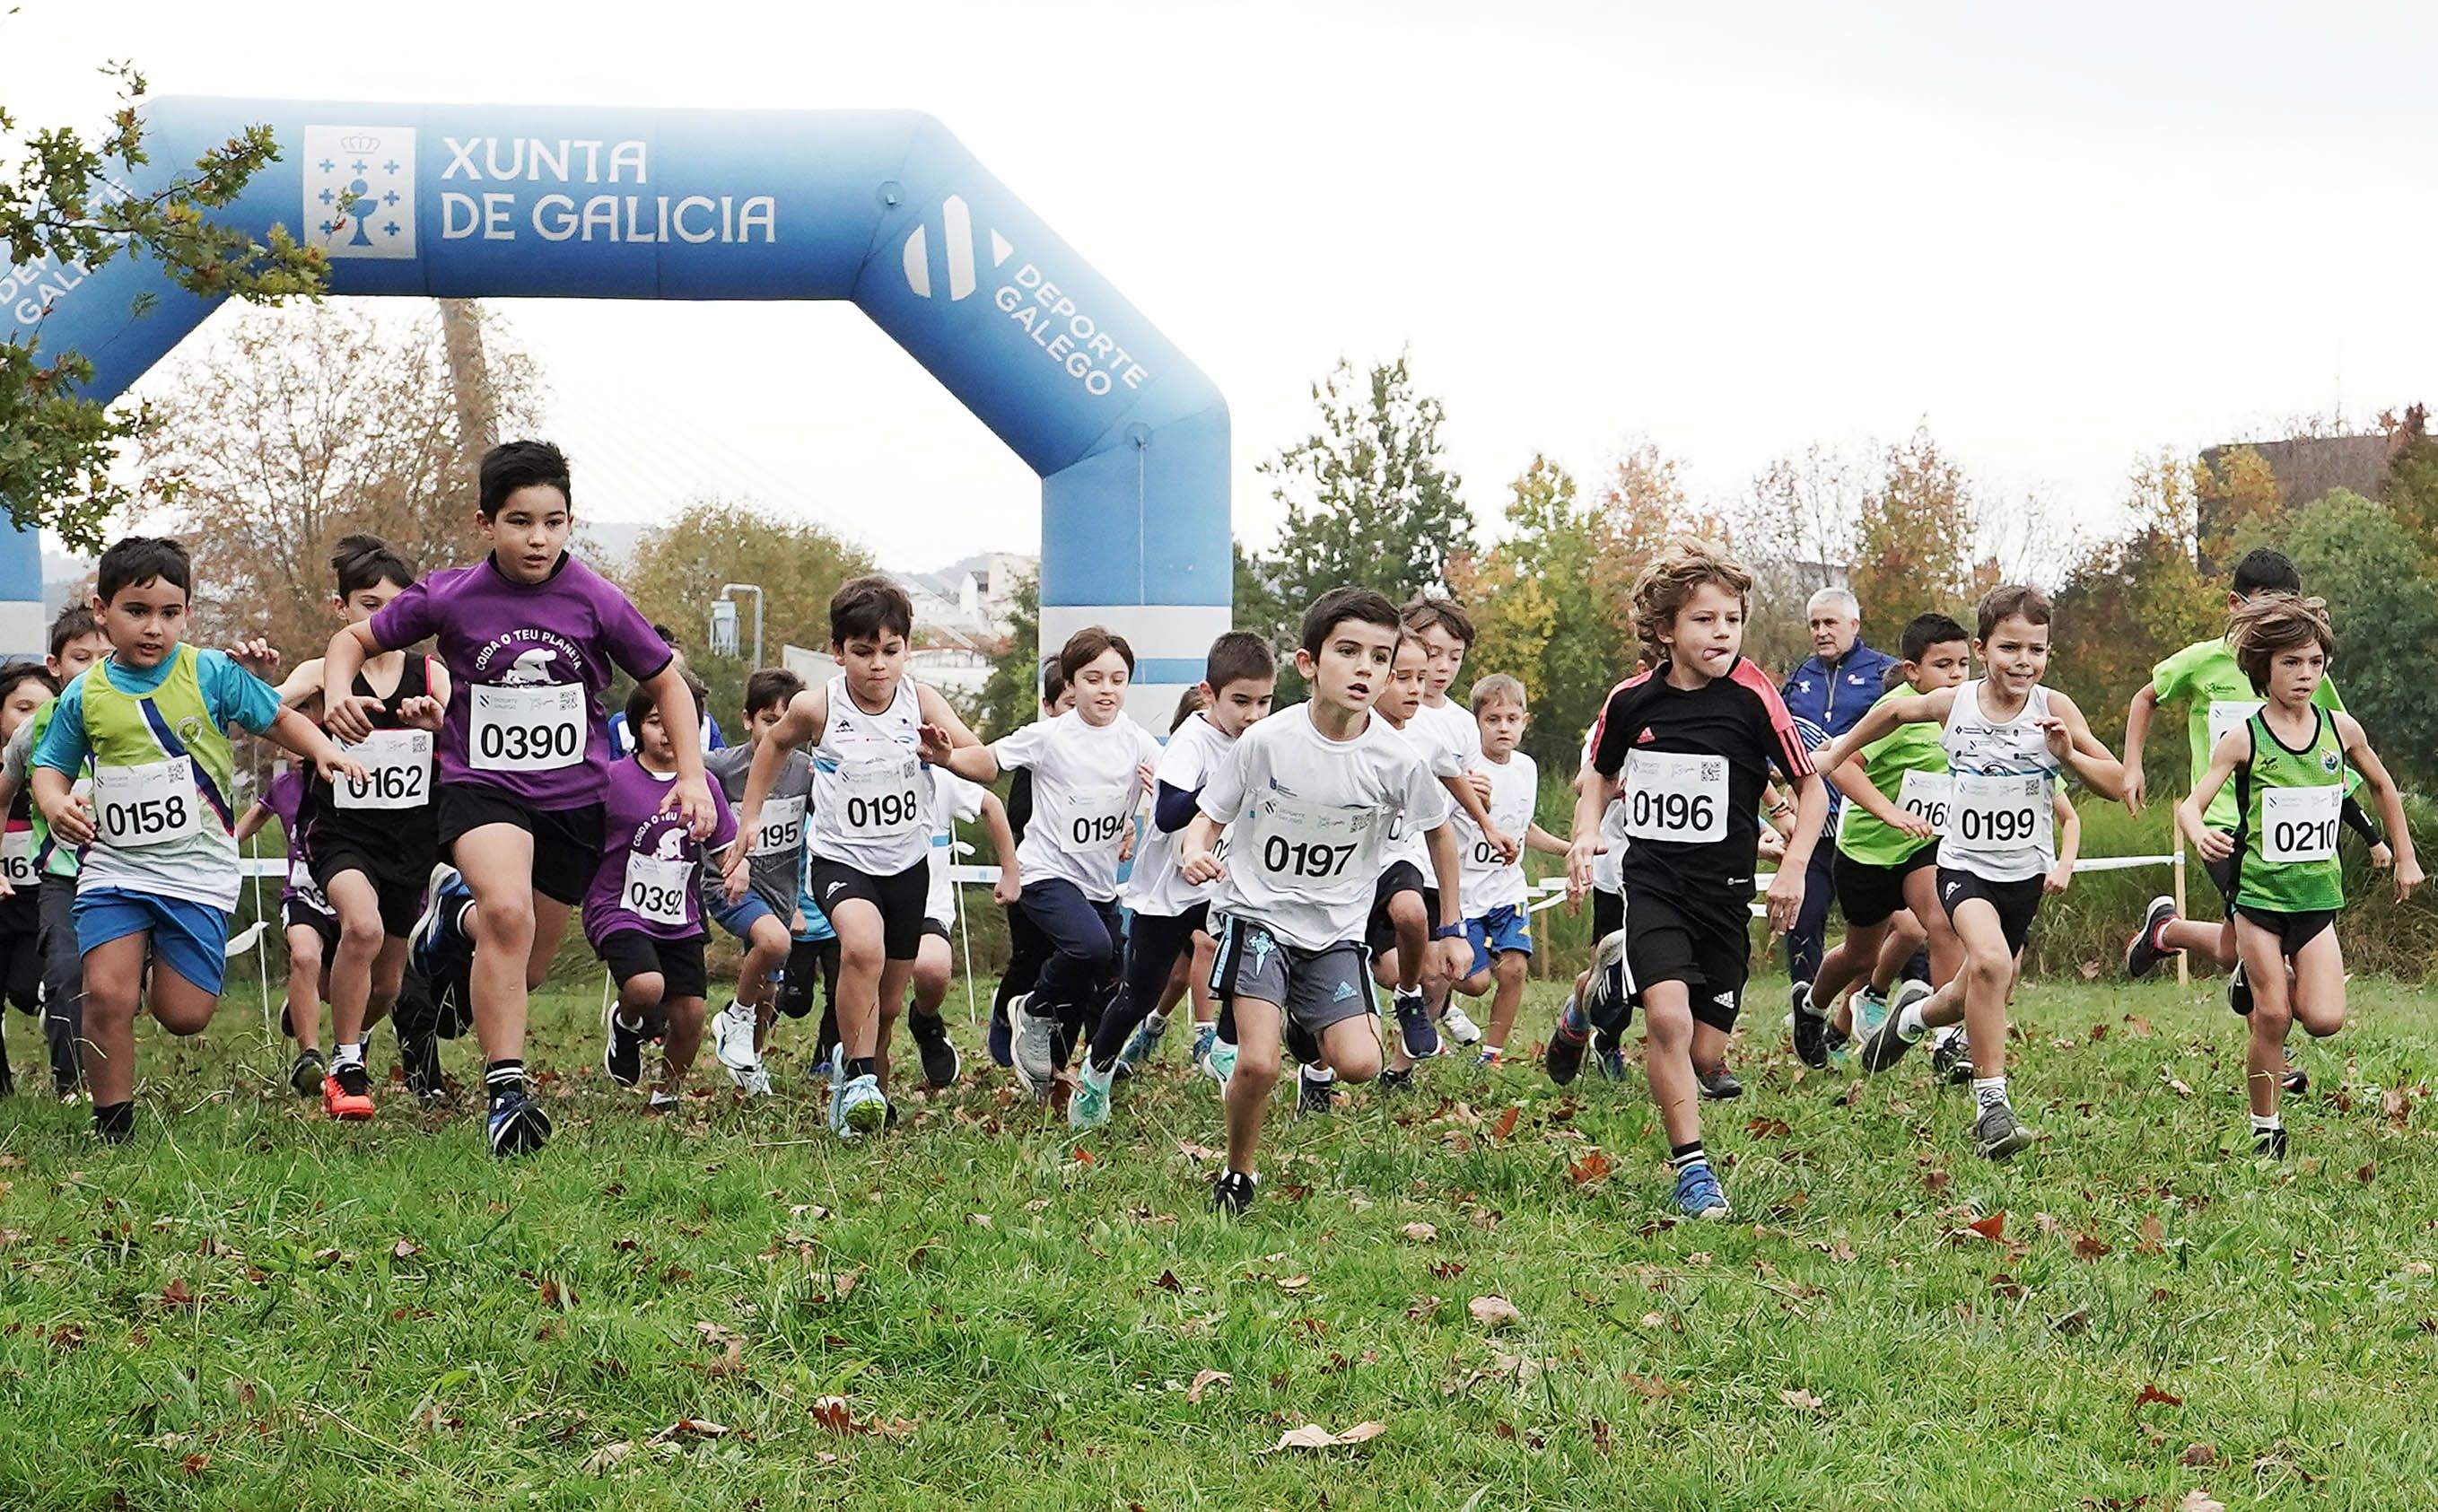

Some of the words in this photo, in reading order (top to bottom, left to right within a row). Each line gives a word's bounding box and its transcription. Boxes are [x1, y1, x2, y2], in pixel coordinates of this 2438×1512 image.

[441, 136, 647, 184] XUNTA
[441, 192, 515, 240] DE
[531, 194, 776, 244] GALICIA
[994, 285, 1112, 396] GALEGO
[1014, 263, 1149, 389] DEPORTE
[475, 640, 502, 671] COIDA
[500, 633, 511, 645] O
[512, 629, 539, 642] TEU
[541, 632, 582, 670] PLANETA
[480, 722, 577, 760] 0390
[106, 795, 188, 836] 0158
[847, 790, 916, 827] 0198
[1072, 810, 1127, 843] 0194
[1633, 790, 1714, 832] 0196
[1962, 808, 2035, 842] 0199
[633, 821, 652, 847] COIDA
[651, 815, 660, 825] O
[760, 820, 798, 848] 195
[2275, 818, 2336, 853] 0210
[1264, 835, 1358, 878] 0197
